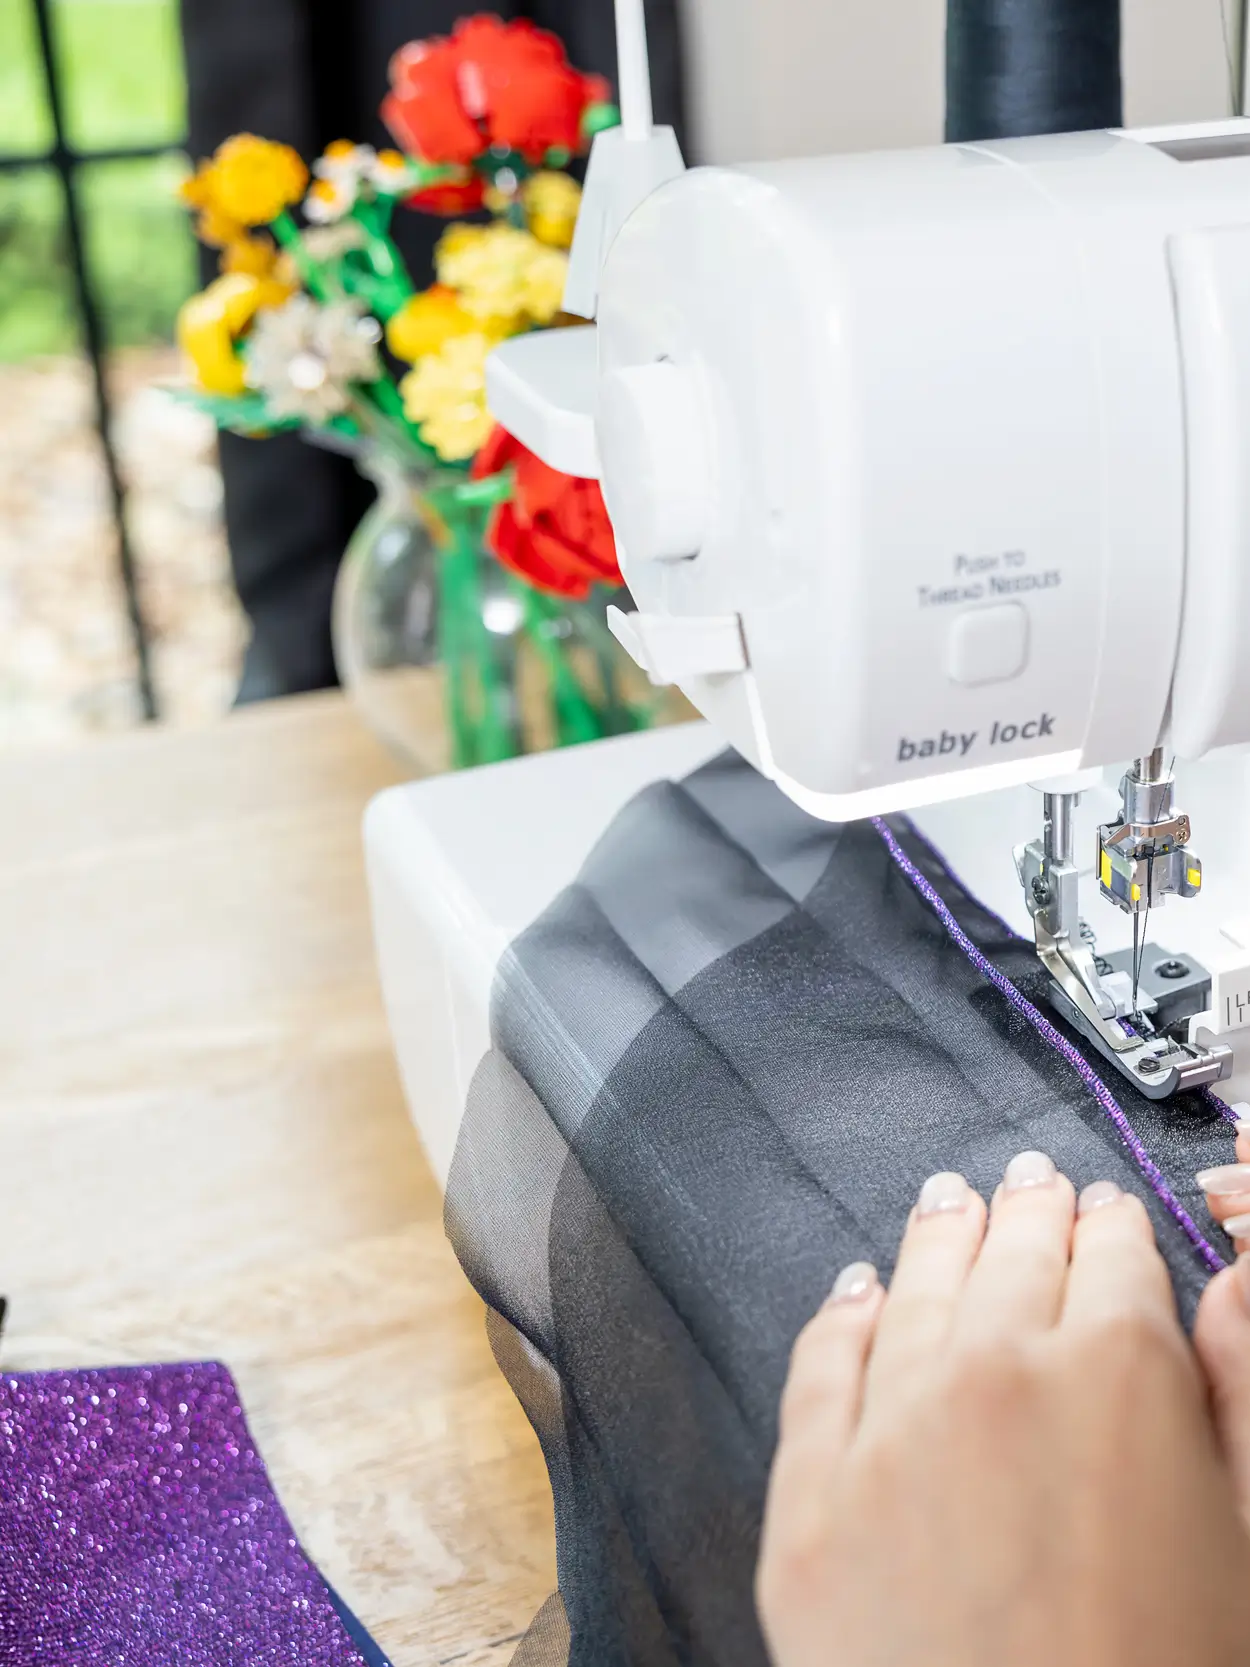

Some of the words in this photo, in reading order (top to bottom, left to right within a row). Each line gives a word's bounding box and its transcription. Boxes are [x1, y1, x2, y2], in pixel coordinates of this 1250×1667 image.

[954, 553, 999, 575] PUSH
[1003, 550, 1026, 567] TO
[917, 584, 983, 608] THREAD
[989, 570, 1061, 595] NEEDLES
[898, 730, 977, 761] baby
[990, 713, 1056, 745] lock
